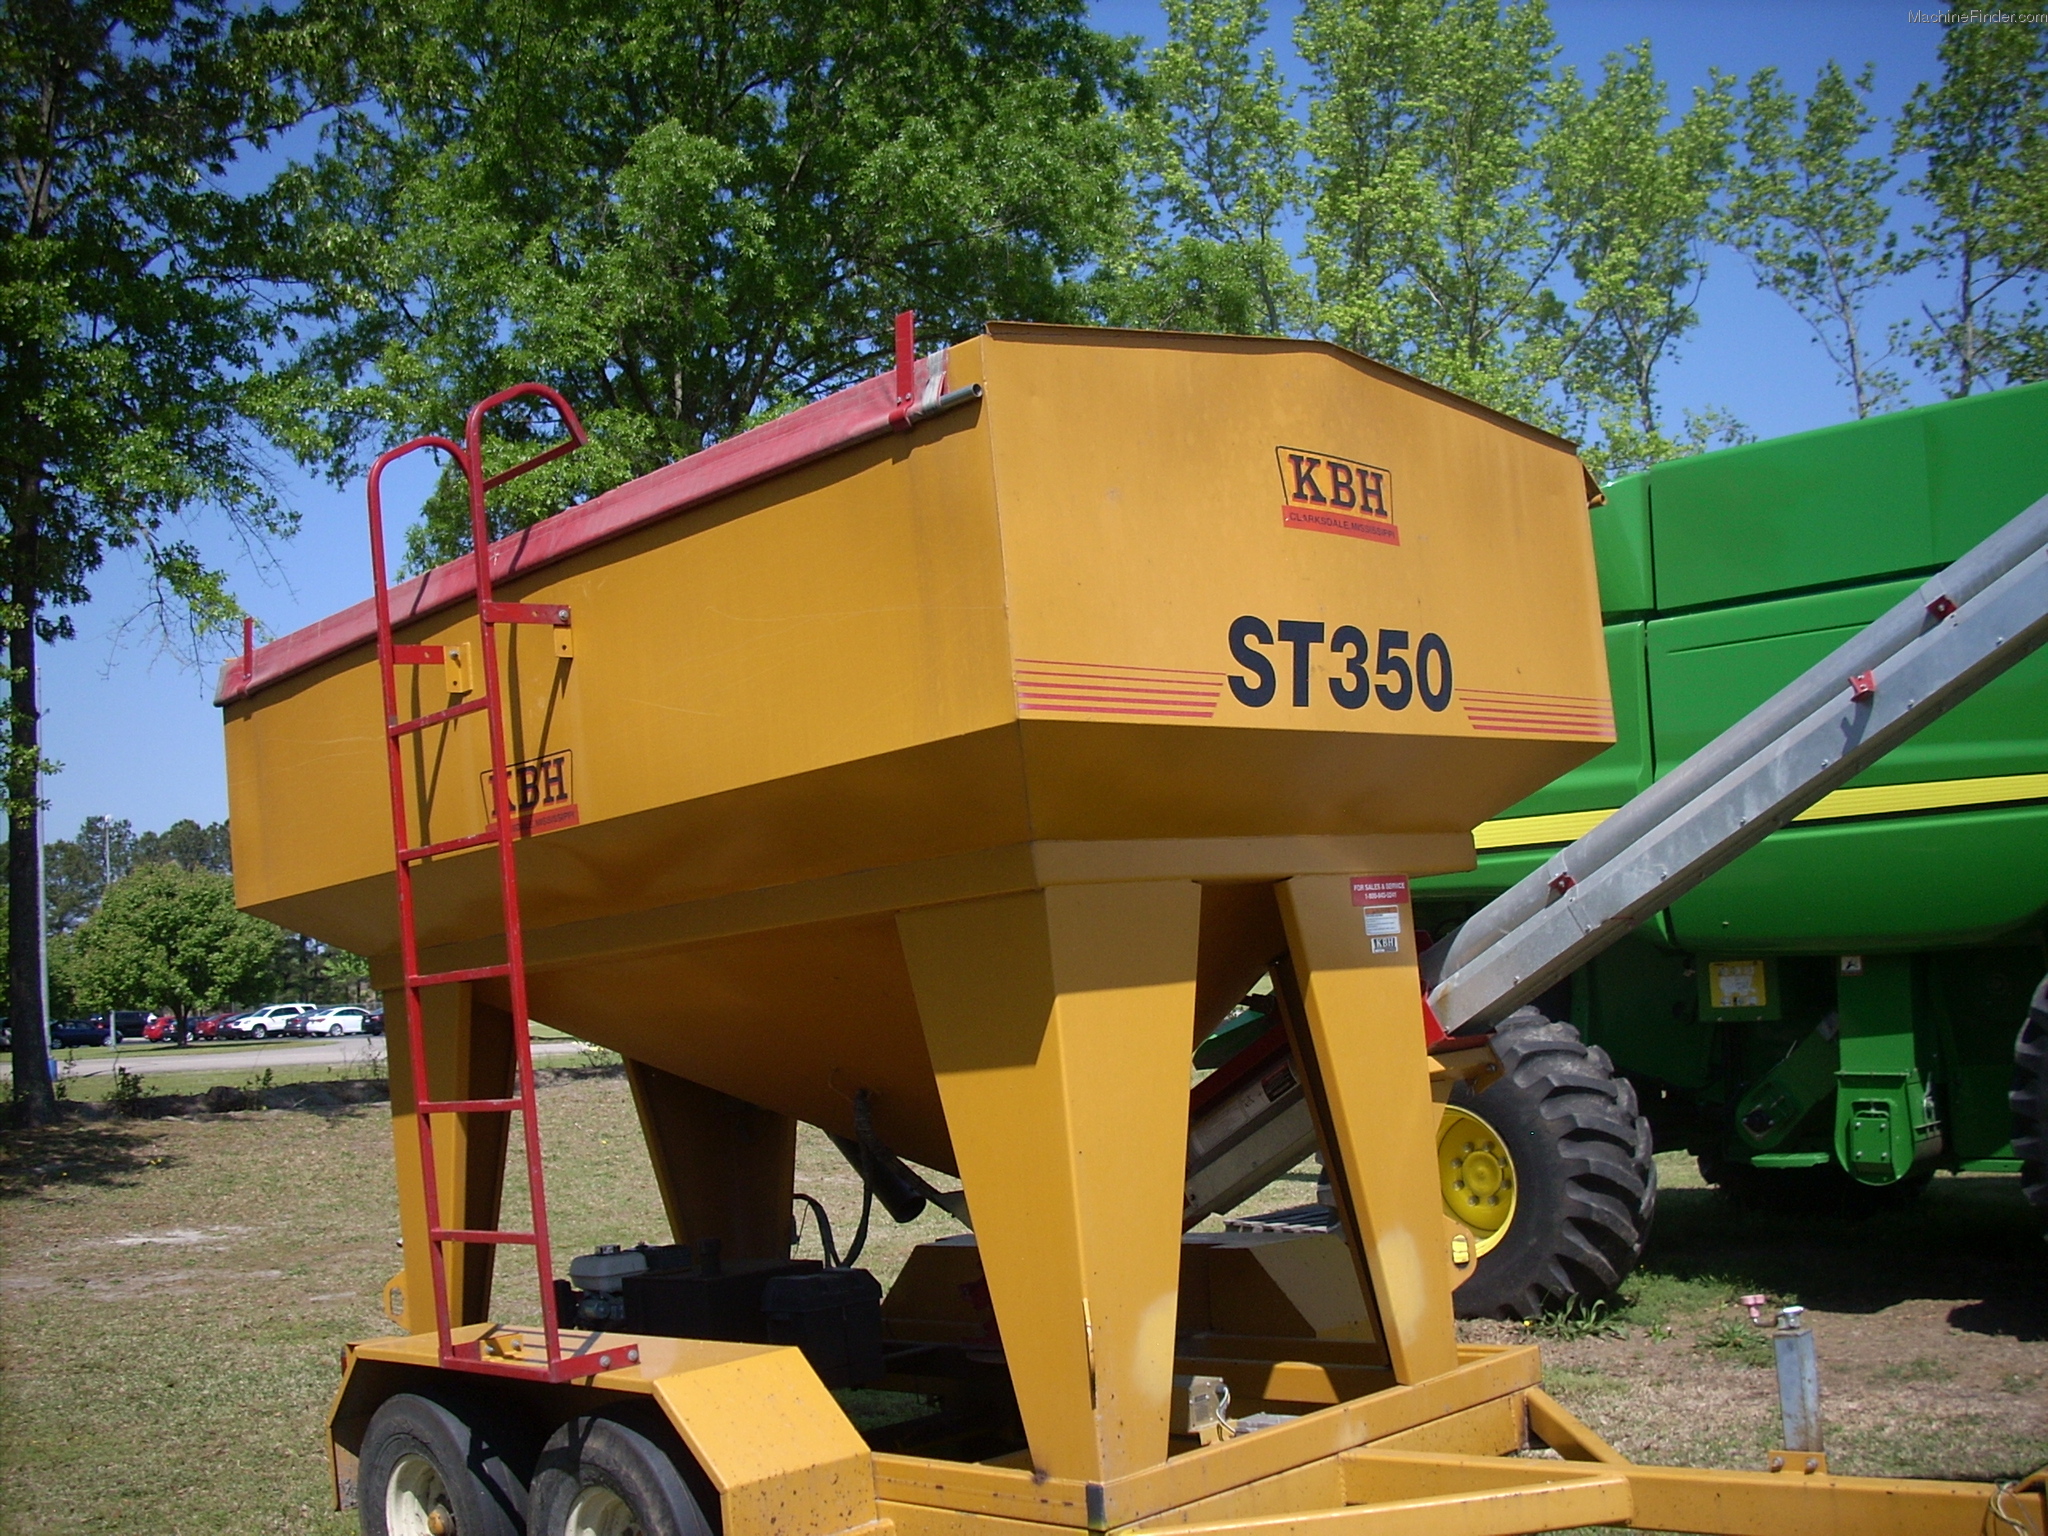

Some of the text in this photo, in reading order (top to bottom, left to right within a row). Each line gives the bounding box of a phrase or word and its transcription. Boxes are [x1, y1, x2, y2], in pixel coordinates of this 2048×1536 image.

[1288, 454, 1388, 519] KBH
[1227, 615, 1453, 713] ST350
[1376, 937, 1394, 948] KBH
